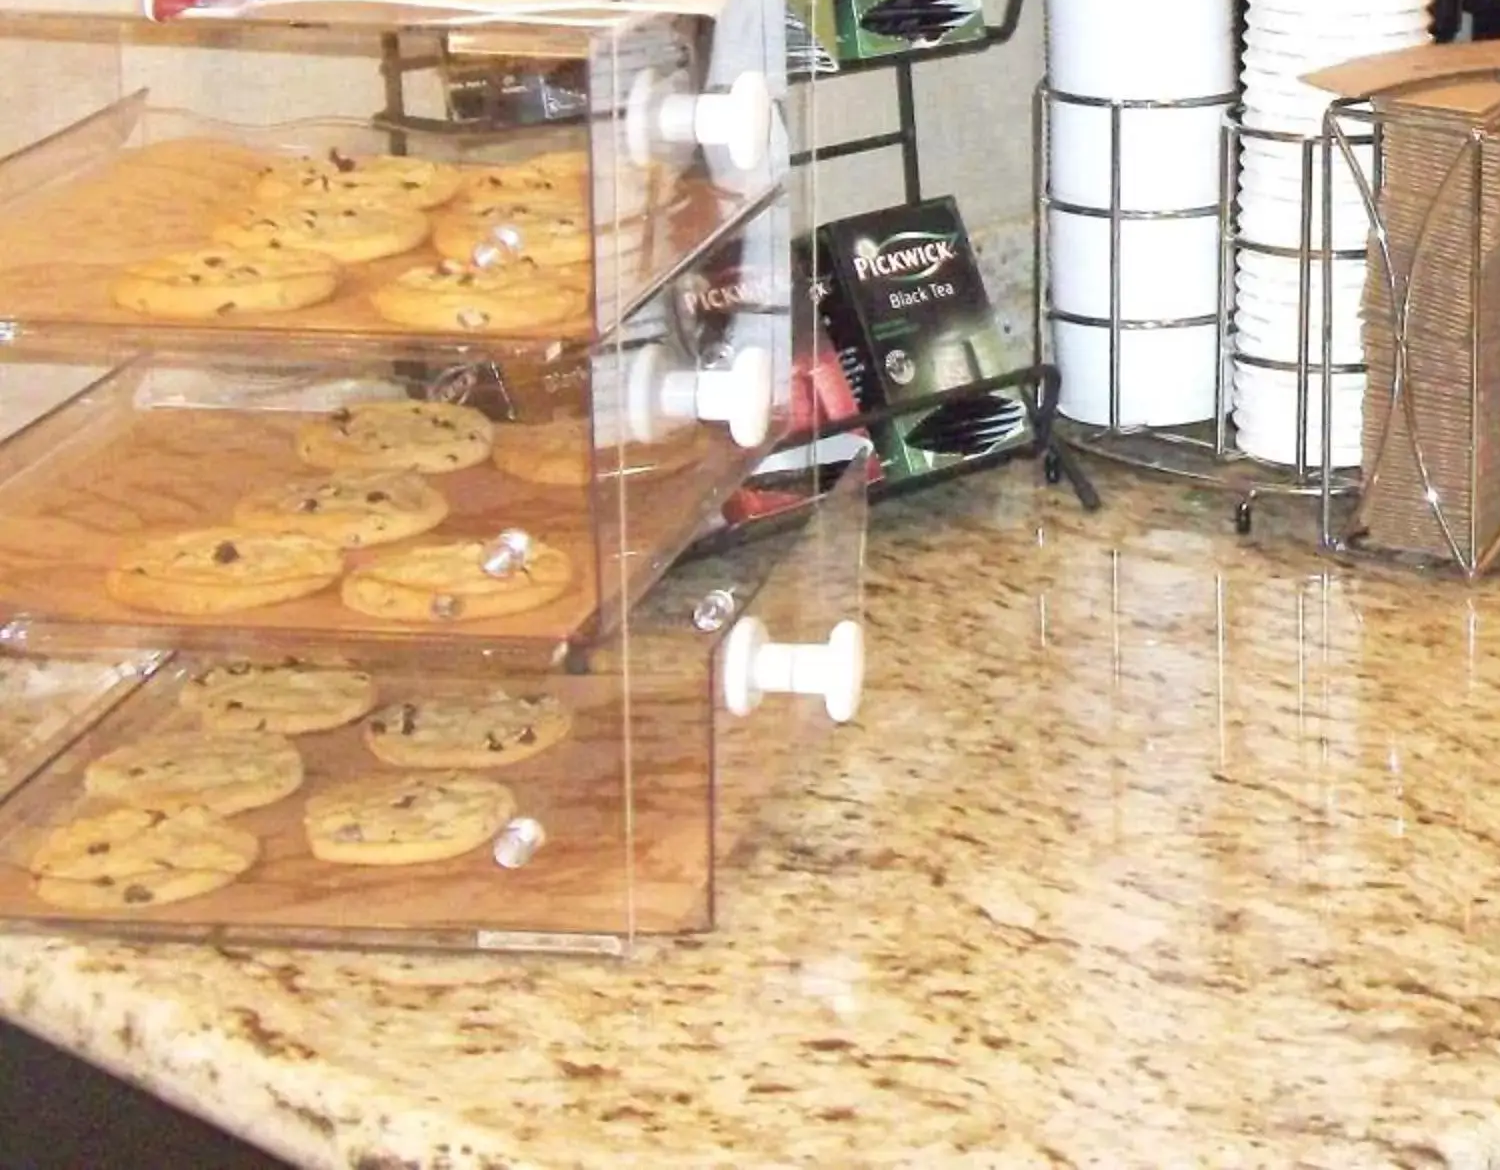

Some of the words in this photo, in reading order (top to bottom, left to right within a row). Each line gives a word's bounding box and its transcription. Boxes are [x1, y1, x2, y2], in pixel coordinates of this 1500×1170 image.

[853, 239, 955, 280] PICKWICK
[888, 284, 928, 310] Black
[930, 281, 955, 301] Tea
